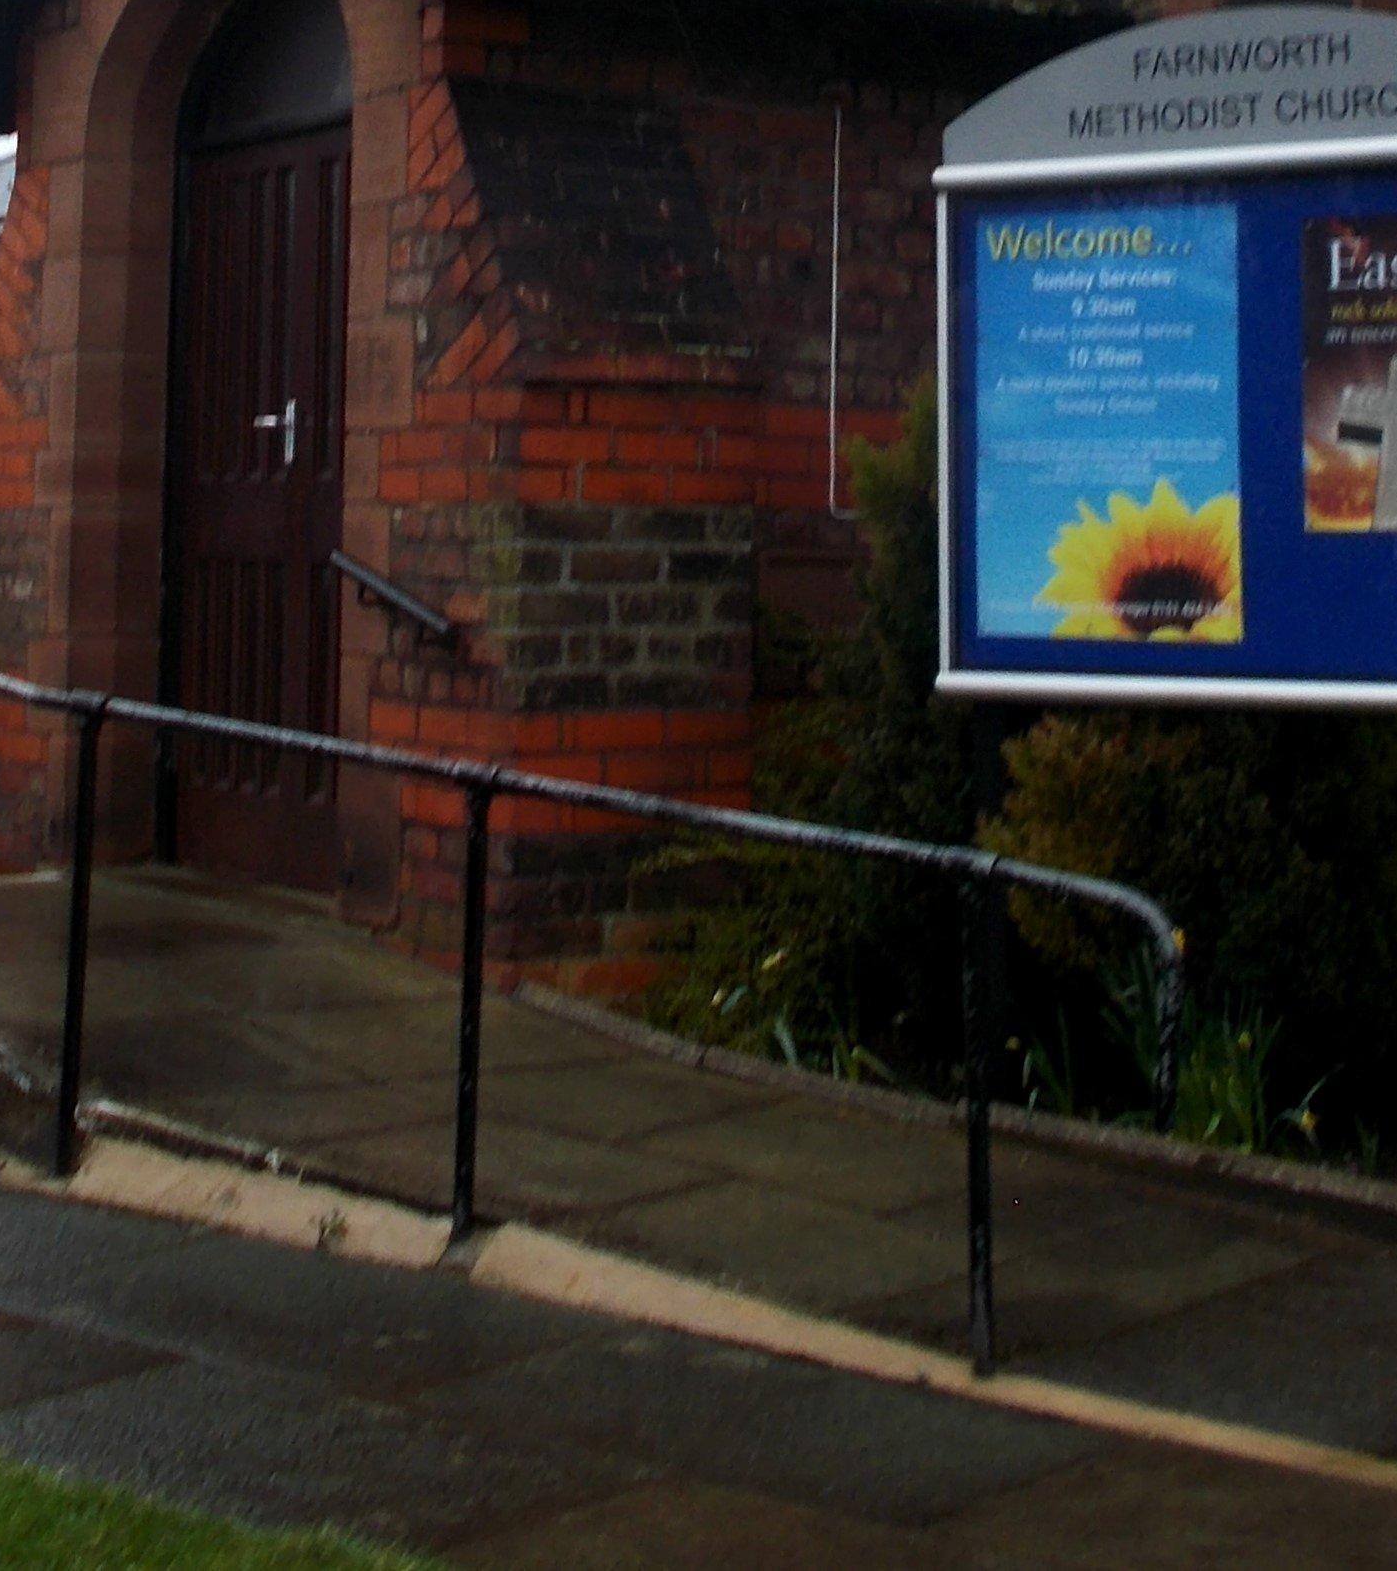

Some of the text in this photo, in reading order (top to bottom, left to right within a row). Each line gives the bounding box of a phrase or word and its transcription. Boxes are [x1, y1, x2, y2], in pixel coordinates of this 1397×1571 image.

[1132, 31, 1352, 81] FARNWORTH
[1067, 90, 1262, 139] METHODIST
[1032, 269, 1094, 293] Sunday
